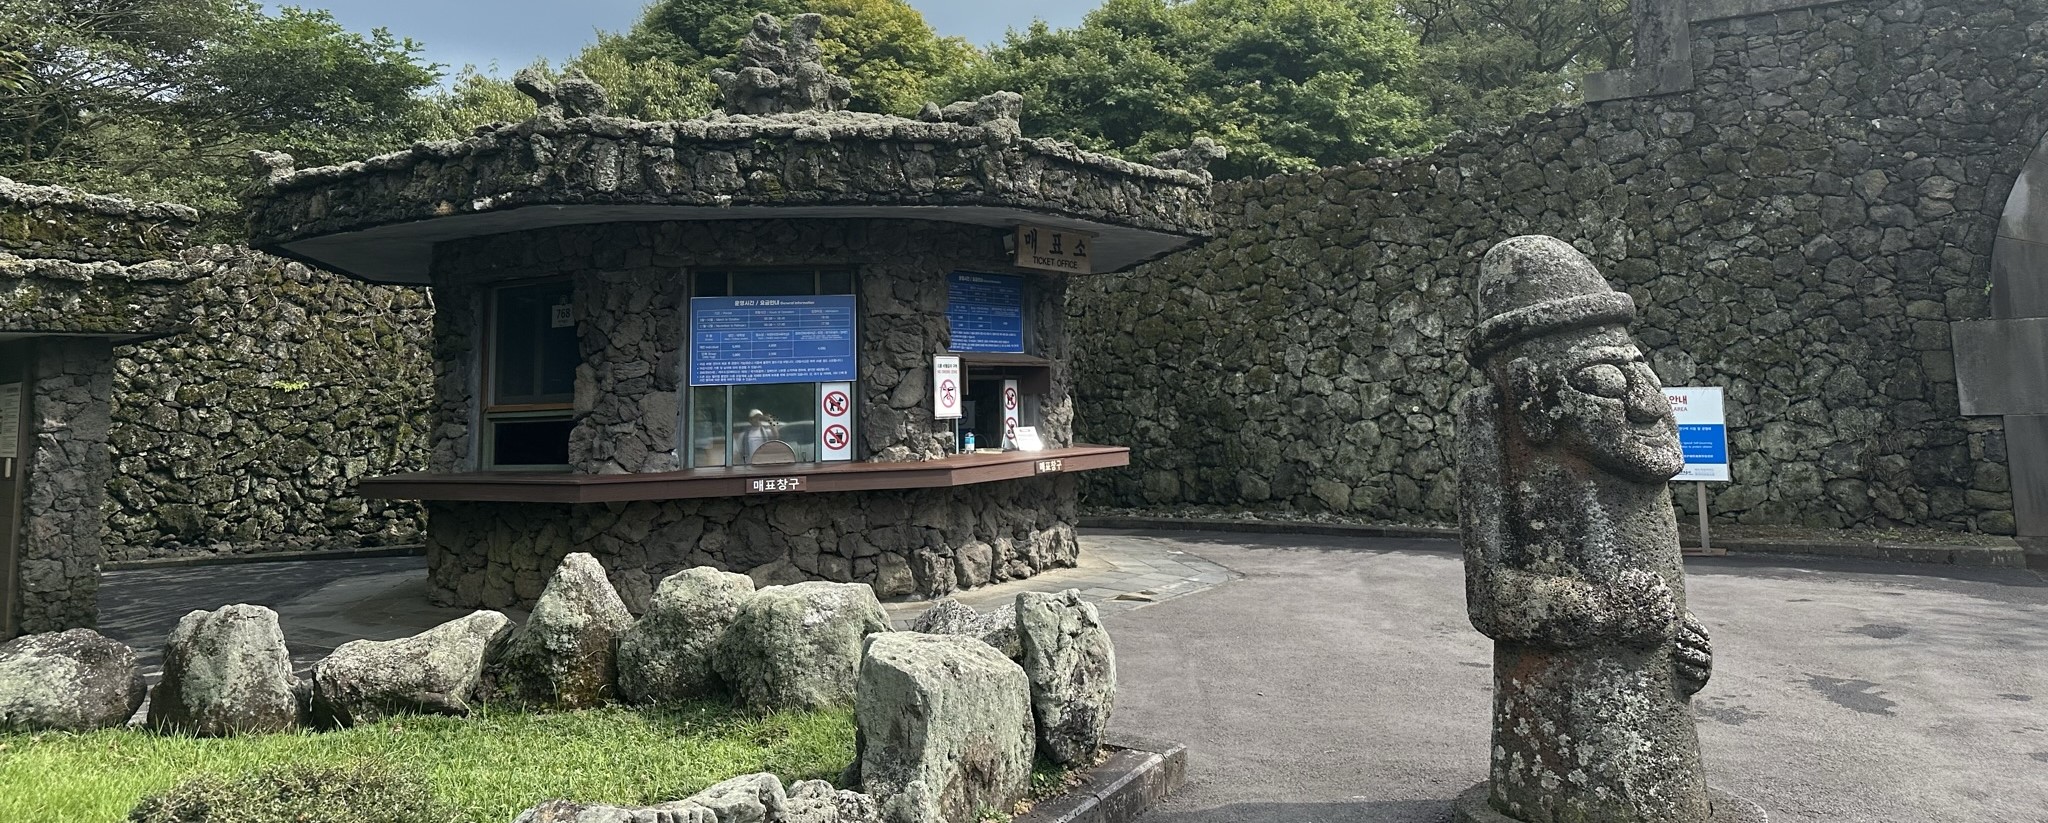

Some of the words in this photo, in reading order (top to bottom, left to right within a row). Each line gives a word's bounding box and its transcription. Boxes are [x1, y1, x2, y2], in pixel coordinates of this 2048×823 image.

[1033, 256, 1055, 266] TICKET
[1057, 258, 1078, 269] OFFICE
[1039, 460, 1062, 472] 매표창구
[753, 478, 800, 492] 매표창구
